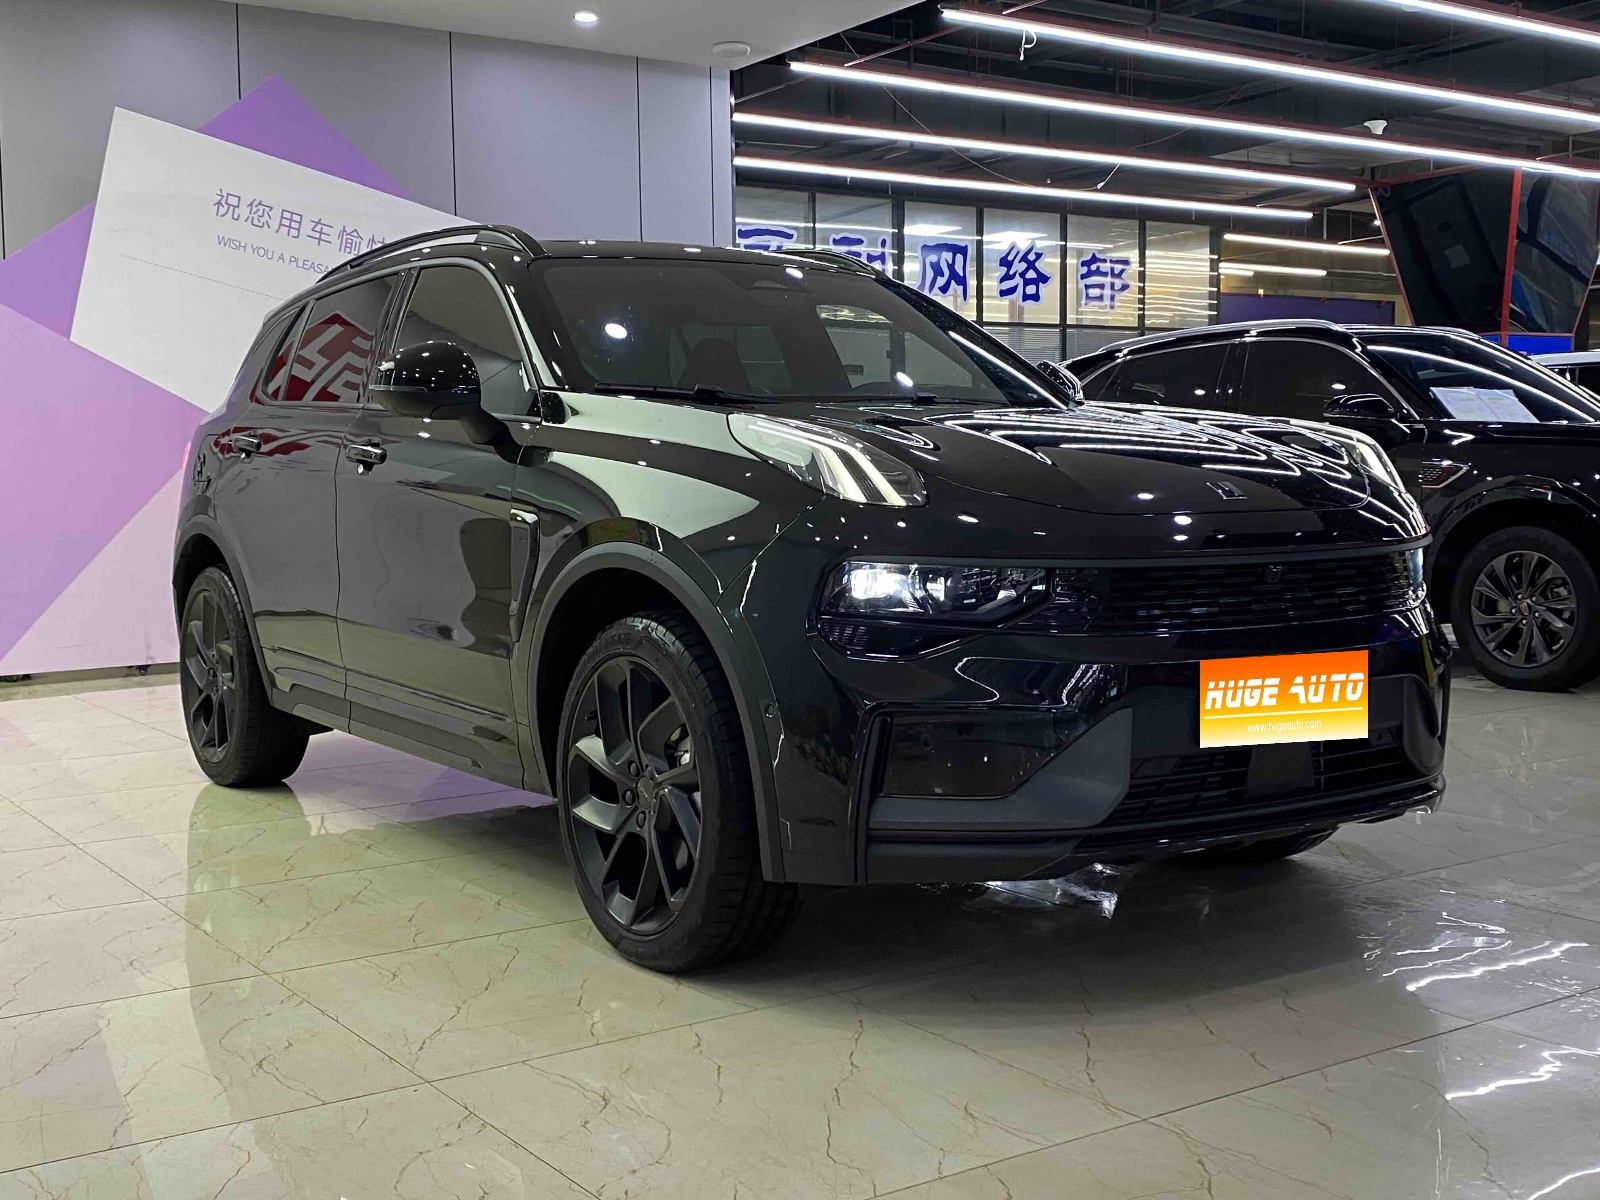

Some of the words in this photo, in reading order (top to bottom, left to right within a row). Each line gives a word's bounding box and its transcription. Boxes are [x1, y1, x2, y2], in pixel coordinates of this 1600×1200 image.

[217, 234, 247, 253] WISH
[251, 243, 275, 260] YOU
[276, 252, 286, 263] A
[288, 255, 333, 275] PLEASA
